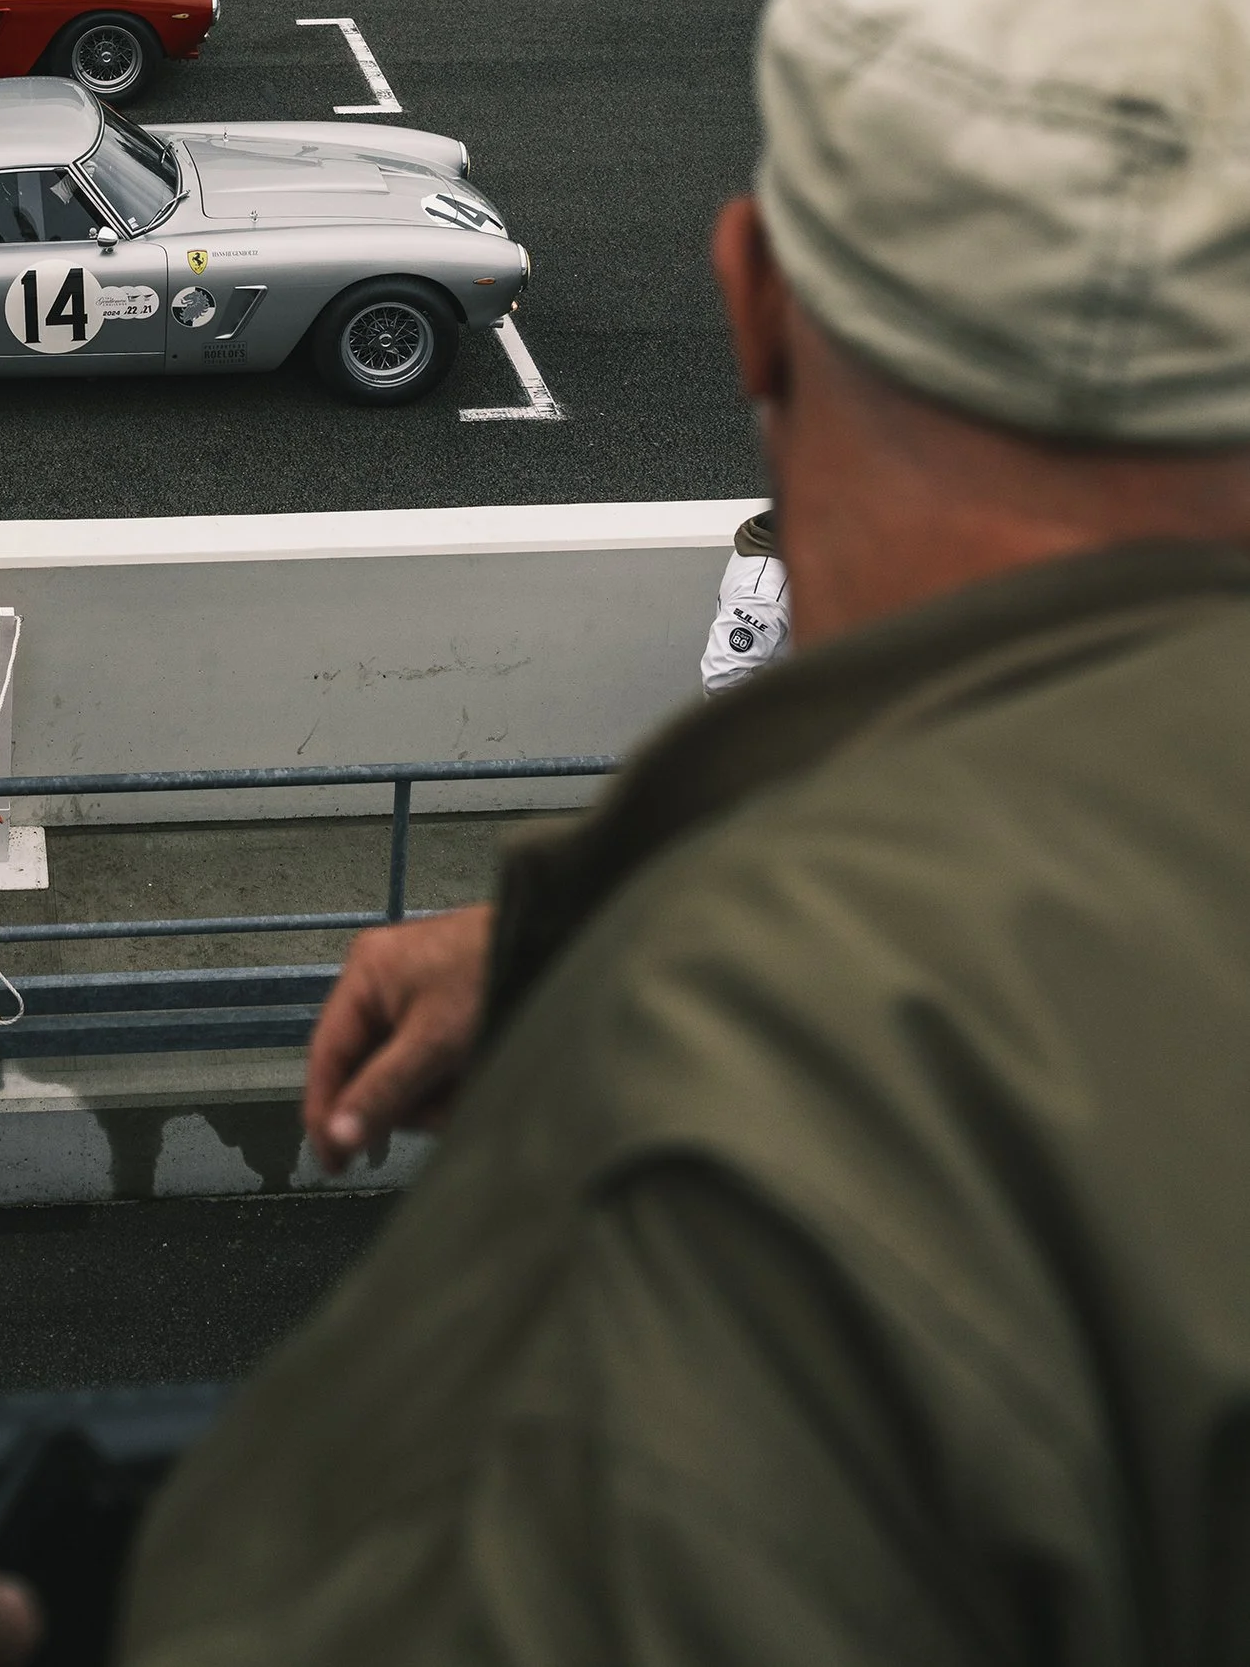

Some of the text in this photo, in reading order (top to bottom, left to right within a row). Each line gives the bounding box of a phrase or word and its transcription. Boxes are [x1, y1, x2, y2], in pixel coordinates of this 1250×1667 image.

[425, 193, 504, 232] 14
[20, 267, 89, 344] 14
[204, 349, 246, 359] ROELOFS
[733, 635, 747, 648] 80
